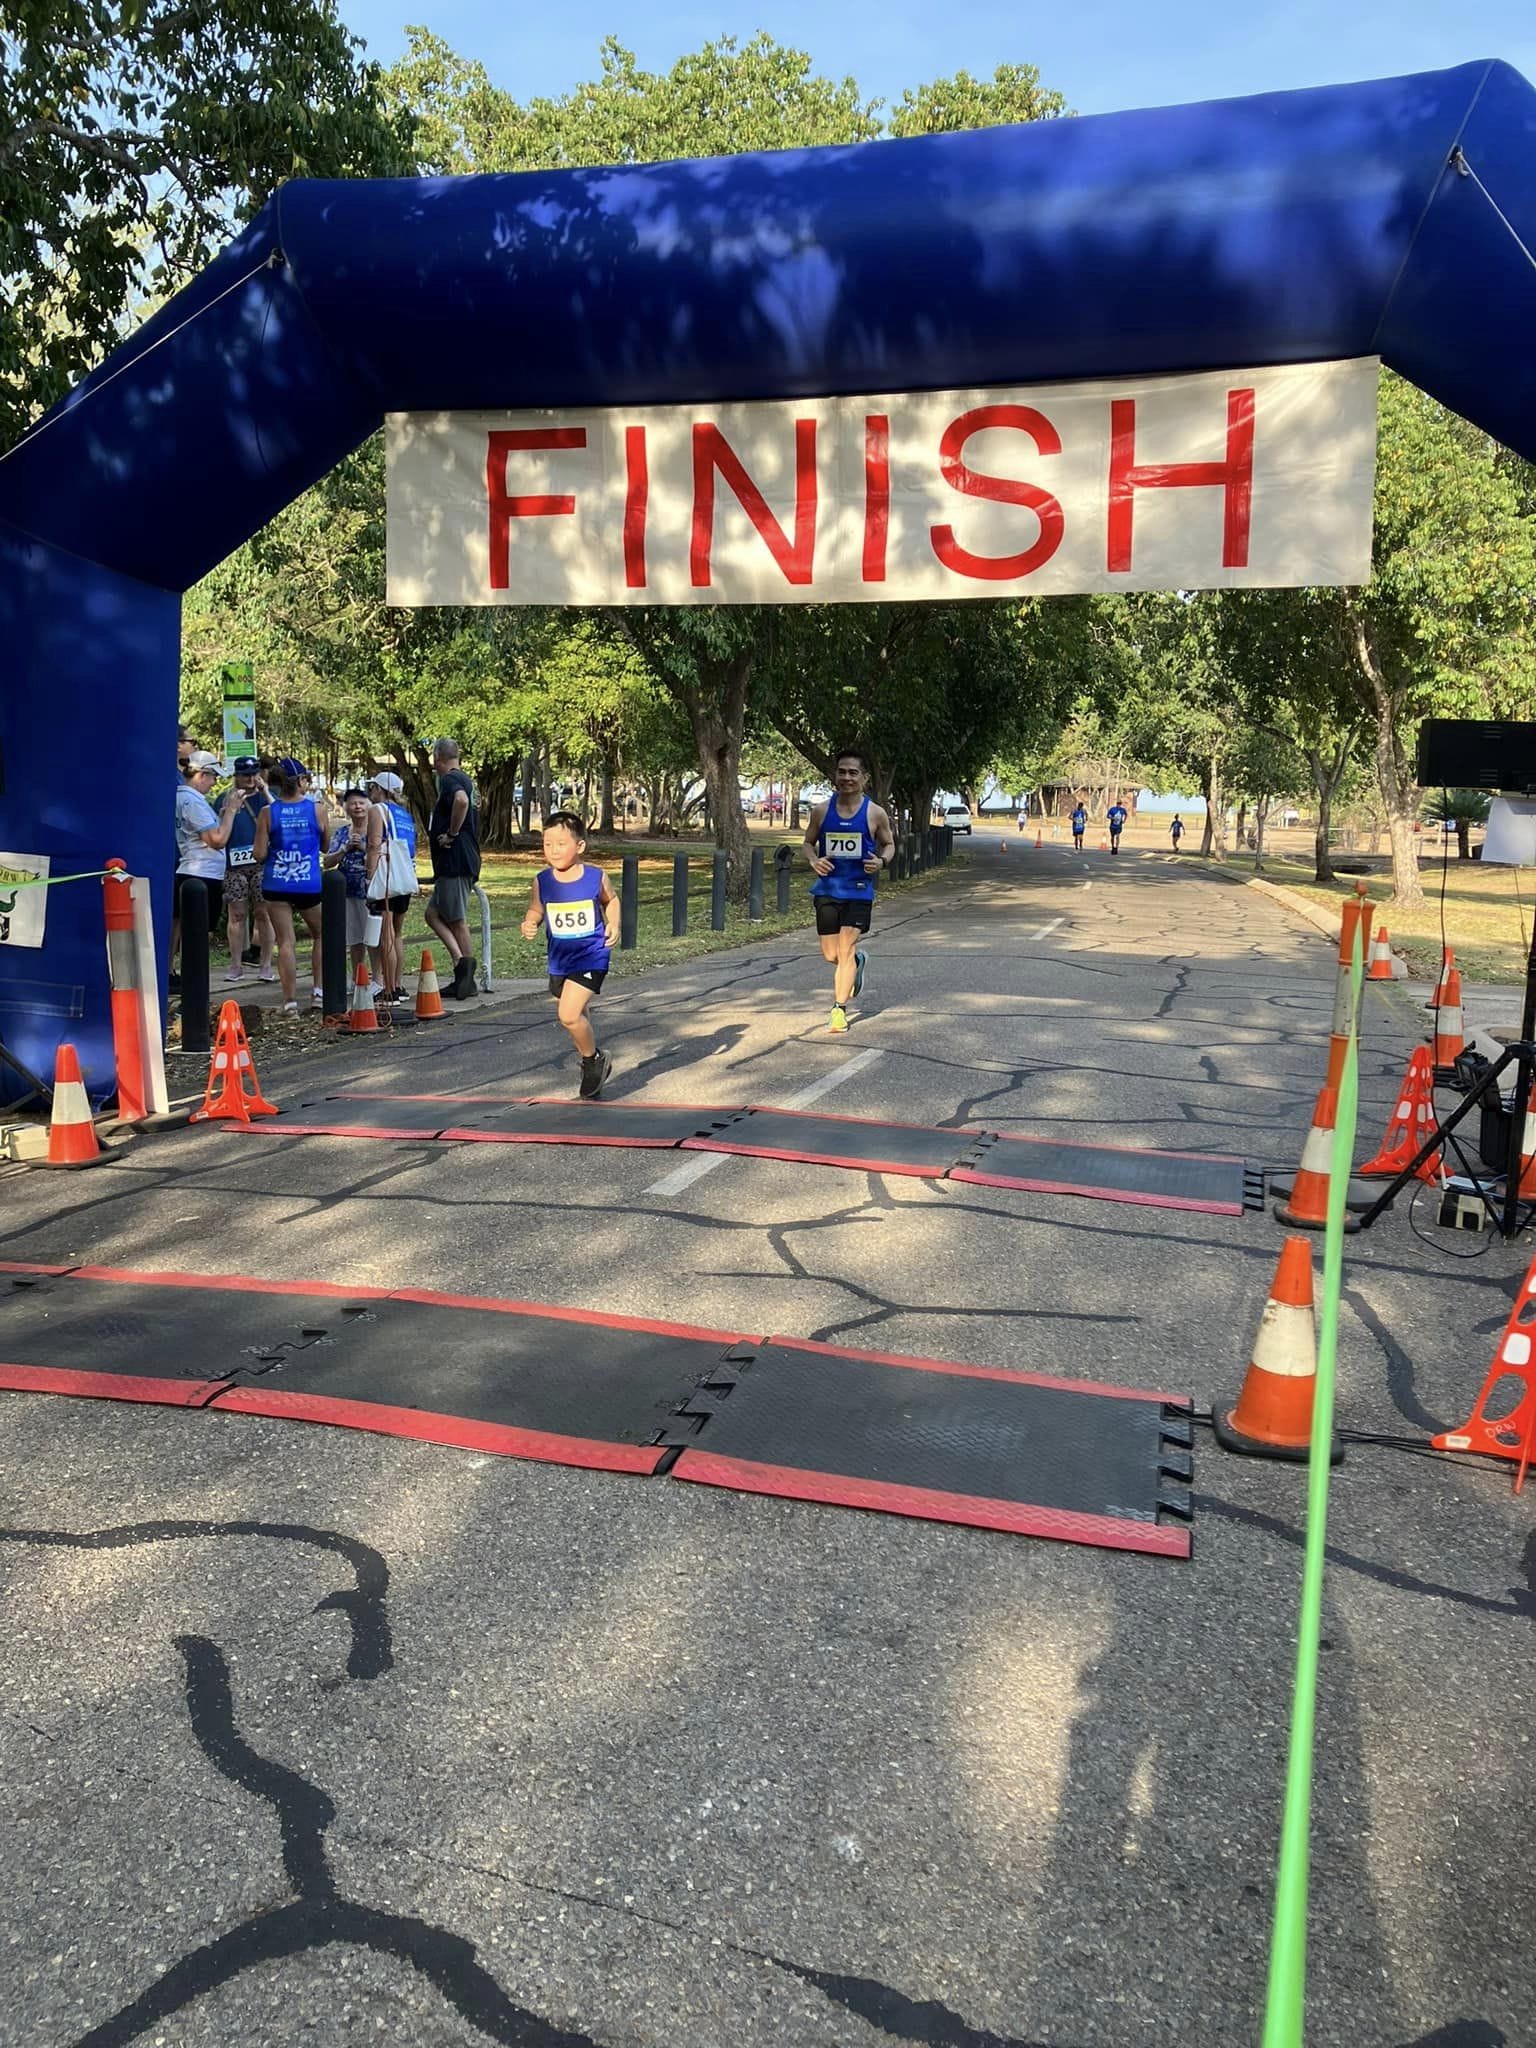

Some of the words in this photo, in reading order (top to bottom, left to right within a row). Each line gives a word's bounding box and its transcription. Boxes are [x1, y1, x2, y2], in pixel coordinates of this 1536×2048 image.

[488, 389, 1256, 590] FINISH
[831, 840, 856, 851] 710
[555, 912, 587, 928] 658
